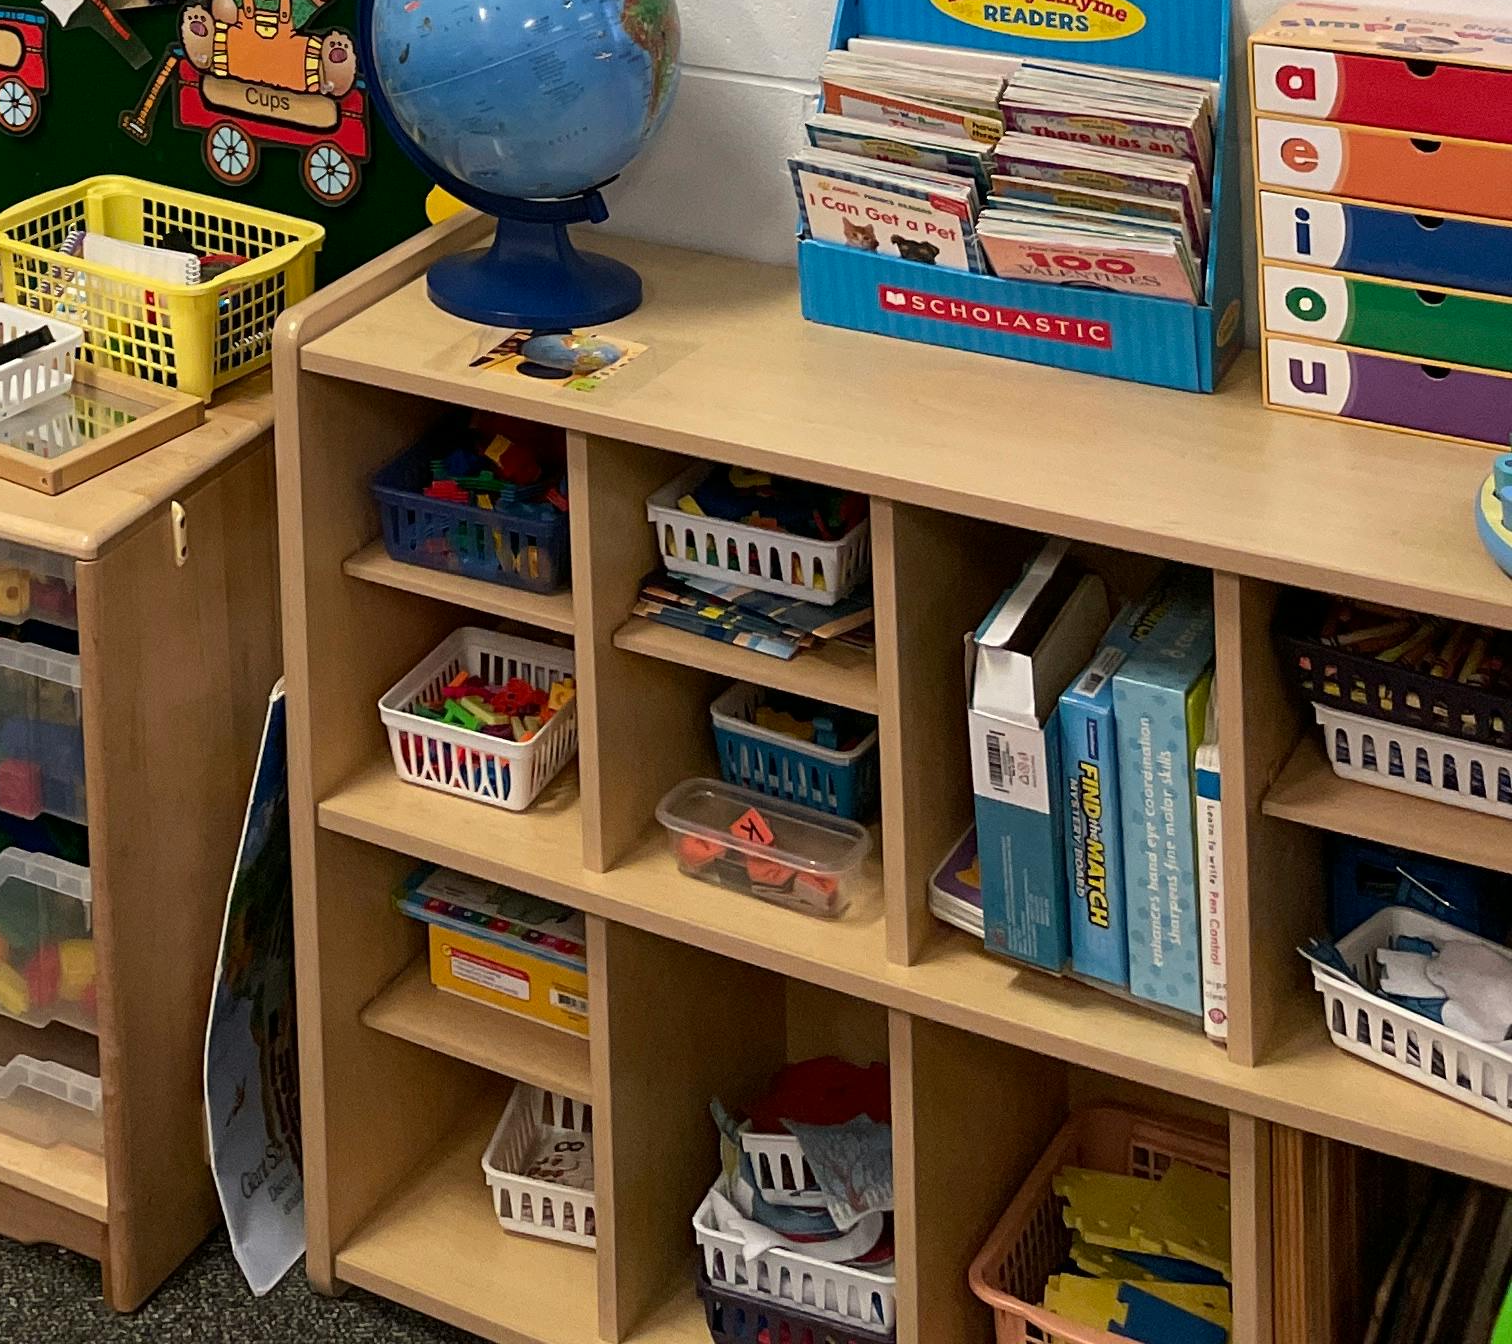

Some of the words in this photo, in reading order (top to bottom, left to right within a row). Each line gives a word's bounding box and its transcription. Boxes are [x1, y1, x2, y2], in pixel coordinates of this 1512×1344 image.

[983, 4, 1090, 33] READERS
[245, 87, 290, 113] Cups
[1275, 64, 1317, 101] a
[1030, 126, 1091, 144] There
[1097, 133, 1141, 149] Was
[1148, 142, 1174, 154] an
[1280, 137, 1319, 173] e
[809, 193, 816, 206] I
[821, 196, 859, 216] Can
[865, 207, 900, 226] Get
[907, 220, 919, 232] a
[925, 222, 956, 241] Pet
[1294, 207, 1311, 256] i
[1016, 264, 1162, 287] VALENTINES
[1026, 252, 1136, 275] 100
[911, 295, 1106, 342] SCHOLASTIC
[1285, 286, 1327, 323] o
[1289, 358, 1328, 396] u
[1138, 717, 1156, 816] coordination
[1156, 750, 1173, 786] skills
[1078, 760, 1102, 820] FIND
[1160, 789, 1175, 837] motor
[1145, 851, 1160, 891] hand
[1164, 841, 1179, 871] fine
[1085, 836, 1110, 930] MATCH
[1167, 875, 1182, 945] sharpens
[1209, 891, 1219, 914] Pen
[1149, 896, 1163, 967] enhances
[1209, 918, 1222, 966] Control
